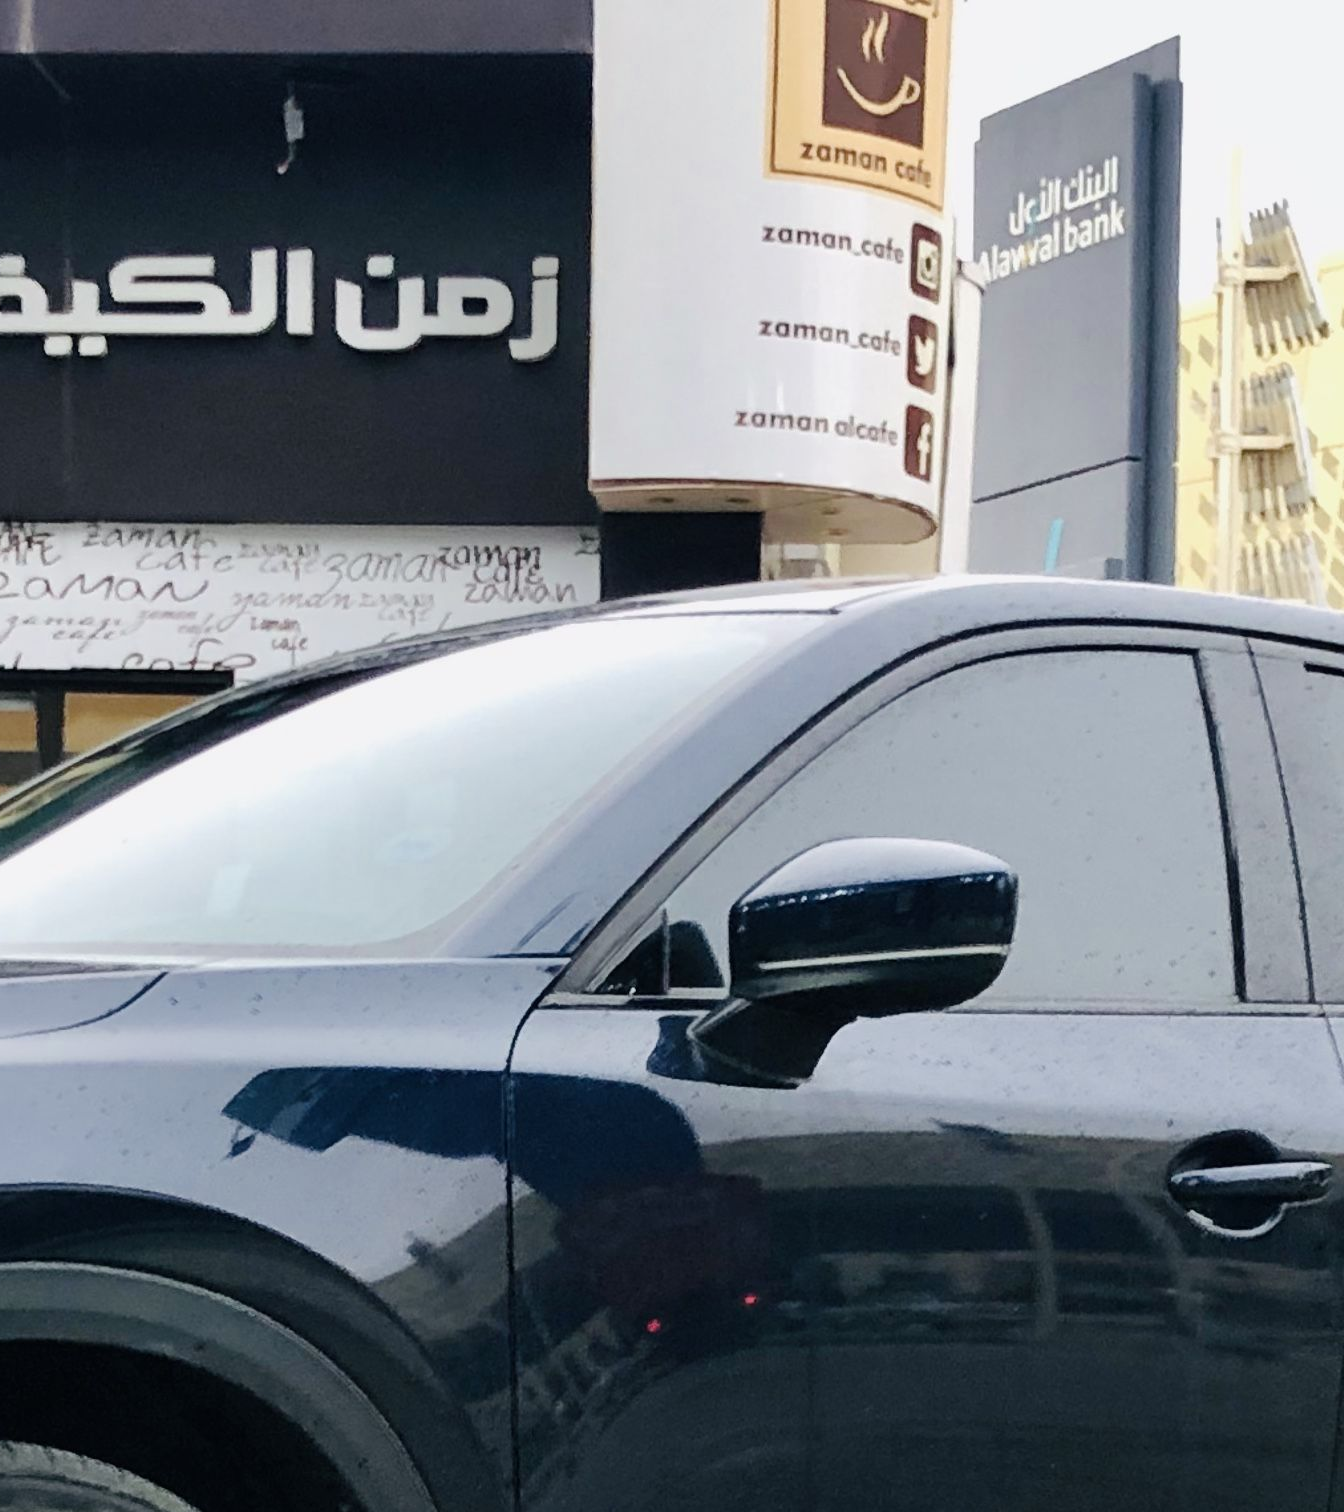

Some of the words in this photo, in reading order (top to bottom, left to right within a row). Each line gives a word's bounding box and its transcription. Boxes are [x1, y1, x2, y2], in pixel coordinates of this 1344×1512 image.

[799, 142, 889, 174] zaman
[894, 158, 933, 189] cafe
[1063, 155, 1119, 212] البنك
[761, 225, 905, 264] zaman_cafe
[978, 219, 1061, 286] Alawwal
[1063, 198, 1126, 255] bank
[335, 253, 560, 363] زمن
[758, 319, 902, 357] zaman_cafe
[733, 410, 831, 434] zaman
[833, 415, 900, 447] alcafe
